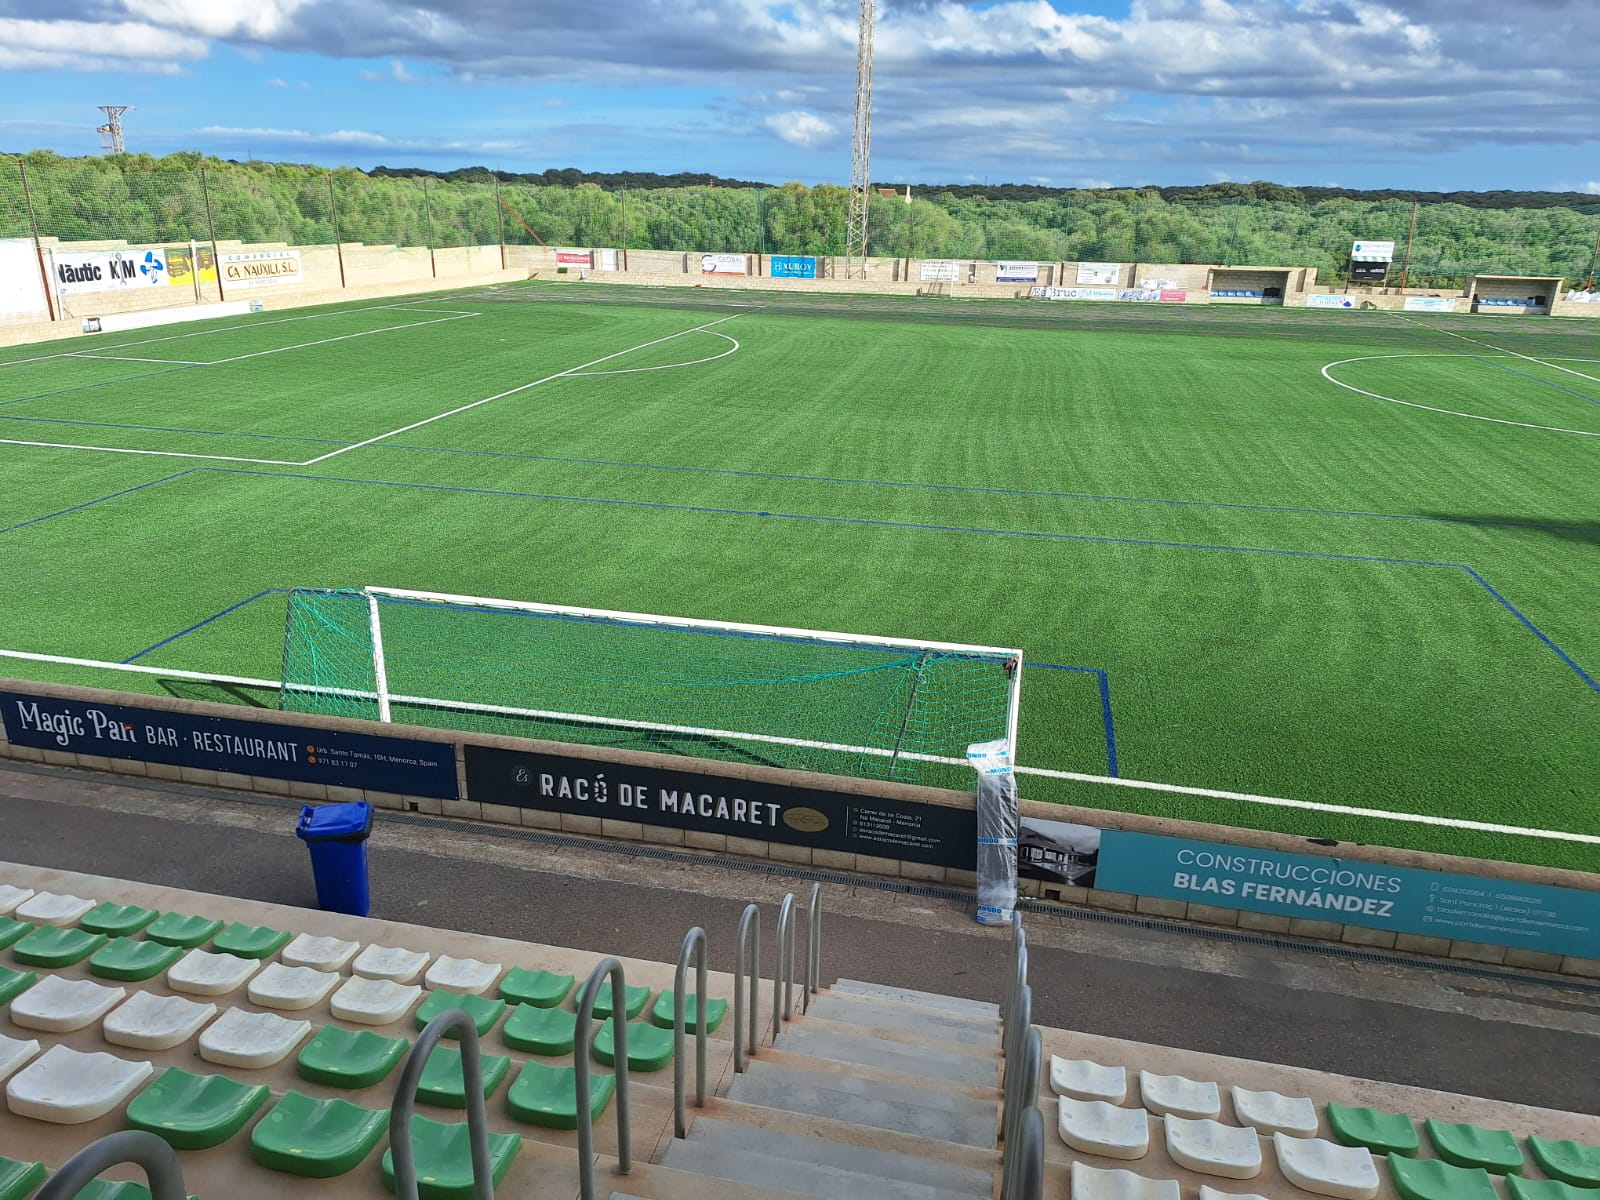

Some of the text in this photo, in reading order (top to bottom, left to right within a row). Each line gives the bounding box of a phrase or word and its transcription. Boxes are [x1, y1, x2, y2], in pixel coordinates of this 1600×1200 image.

[227, 265, 240, 278] CA
[16, 700, 85, 746] Magic
[145, 725, 178, 748] BAR
[192, 731, 298, 762] RESTAURANT
[419, 759, 438, 768] Spain
[539, 773, 608, 803] RACÓ
[618, 783, 648, 809] DE
[658, 788, 781, 827] MACARET
[1177, 849, 1402, 893] CONSTRUCCIONES
[1173, 871, 1395, 918] BLAS FERNÁNDEZ
